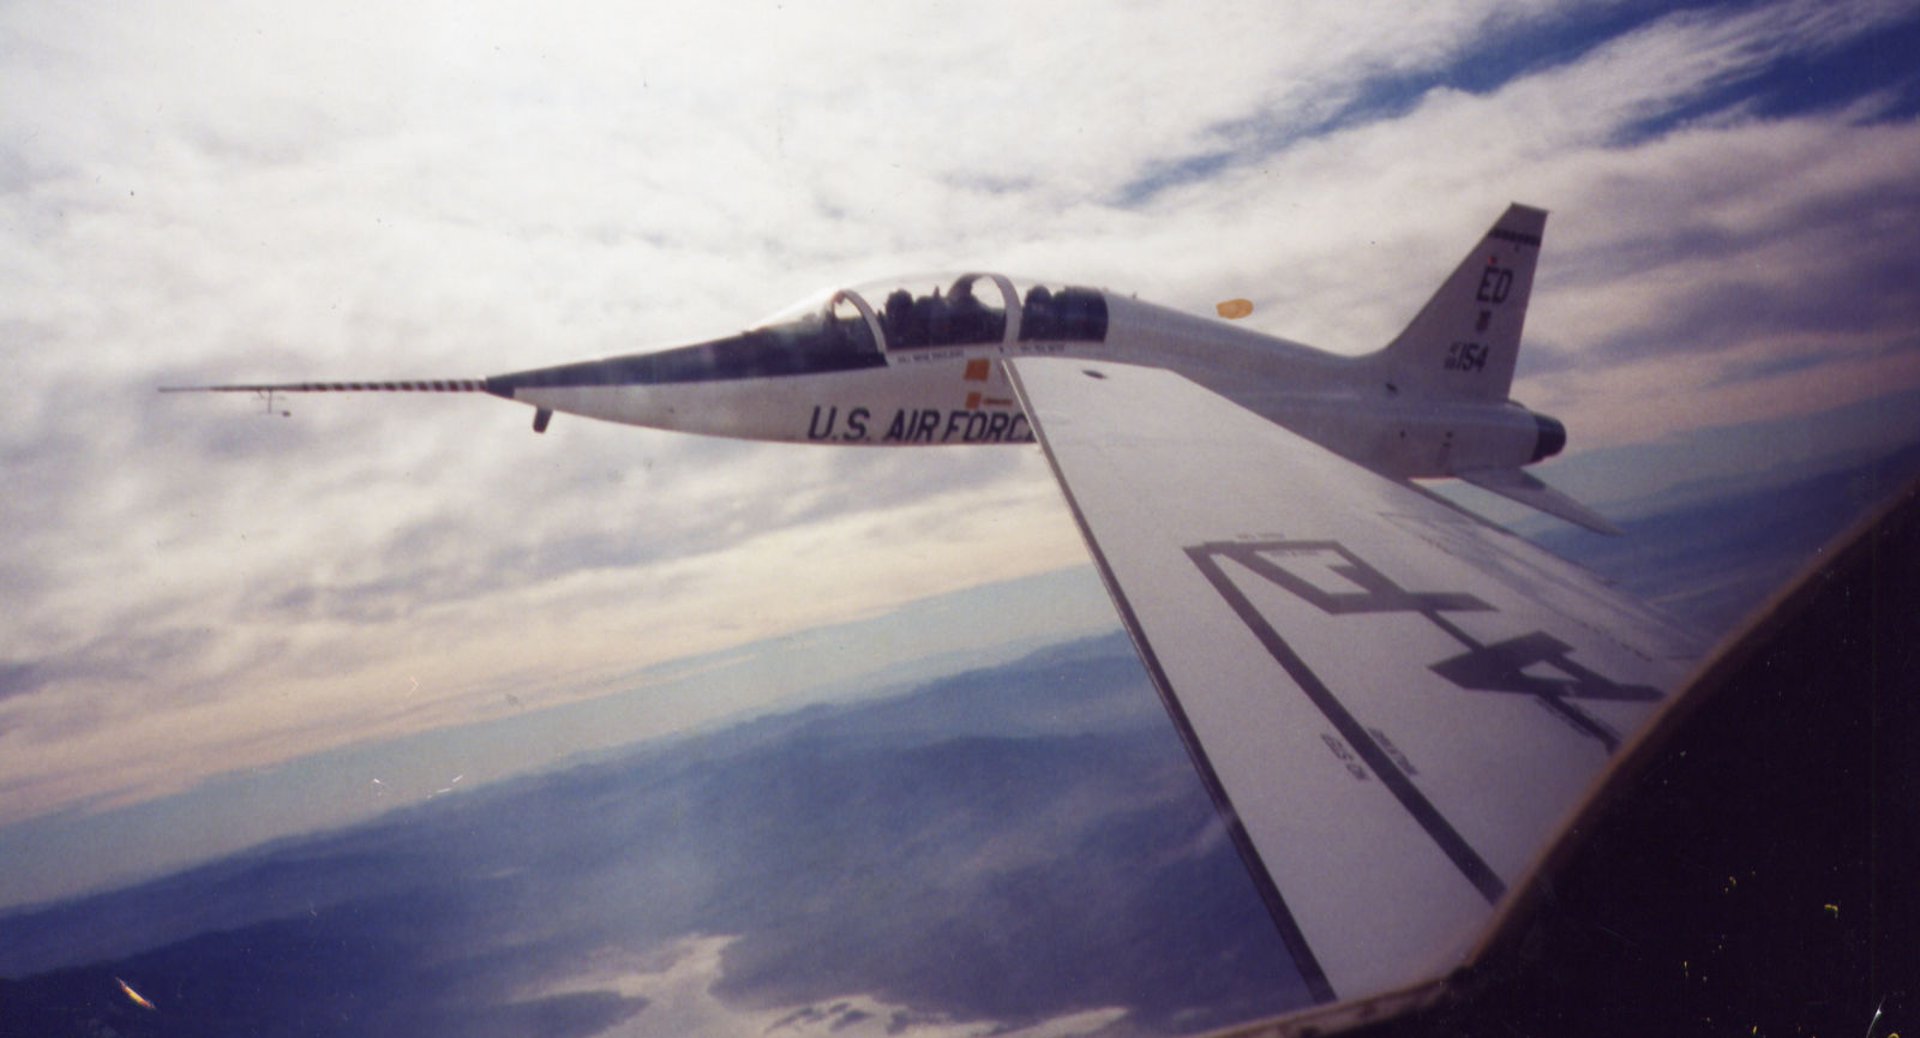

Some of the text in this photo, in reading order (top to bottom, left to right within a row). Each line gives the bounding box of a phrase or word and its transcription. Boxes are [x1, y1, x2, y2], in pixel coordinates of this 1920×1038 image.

[1477, 266, 1513, 304] ED
[807, 405, 1037, 443] U.S. AIR FORC
